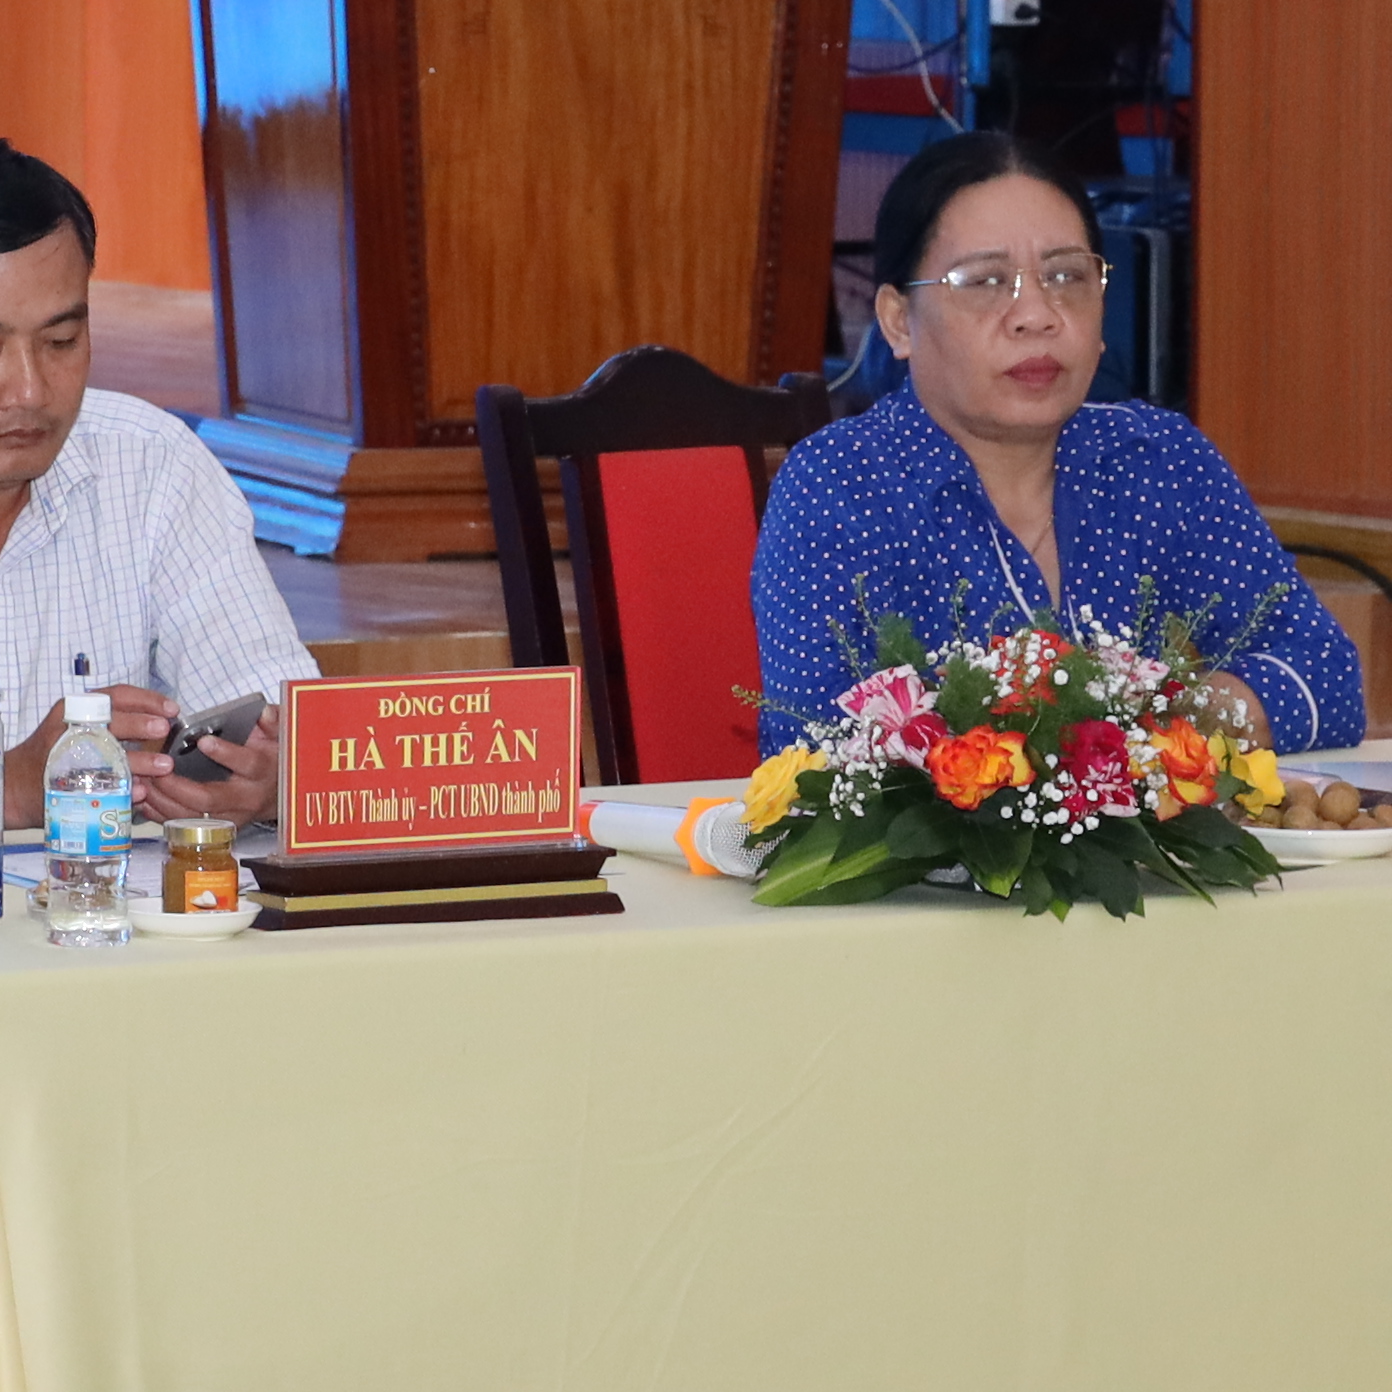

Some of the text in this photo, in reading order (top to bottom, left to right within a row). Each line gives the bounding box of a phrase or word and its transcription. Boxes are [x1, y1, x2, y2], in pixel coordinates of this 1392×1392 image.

[378, 687, 490, 718] ĐỒNG CHÍ
[329, 719, 538, 771] HÀ THẾ ÂN
[306, 792, 325, 826] UV
[329, 791, 357, 824] BTV
[360, 788, 398, 823] Thành
[402, 788, 416, 830] ủy
[430, 785, 457, 819] PCT
[460, 783, 498, 817] UBND
[502, 781, 535, 814] thành
[538, 768, 560, 823] phố
